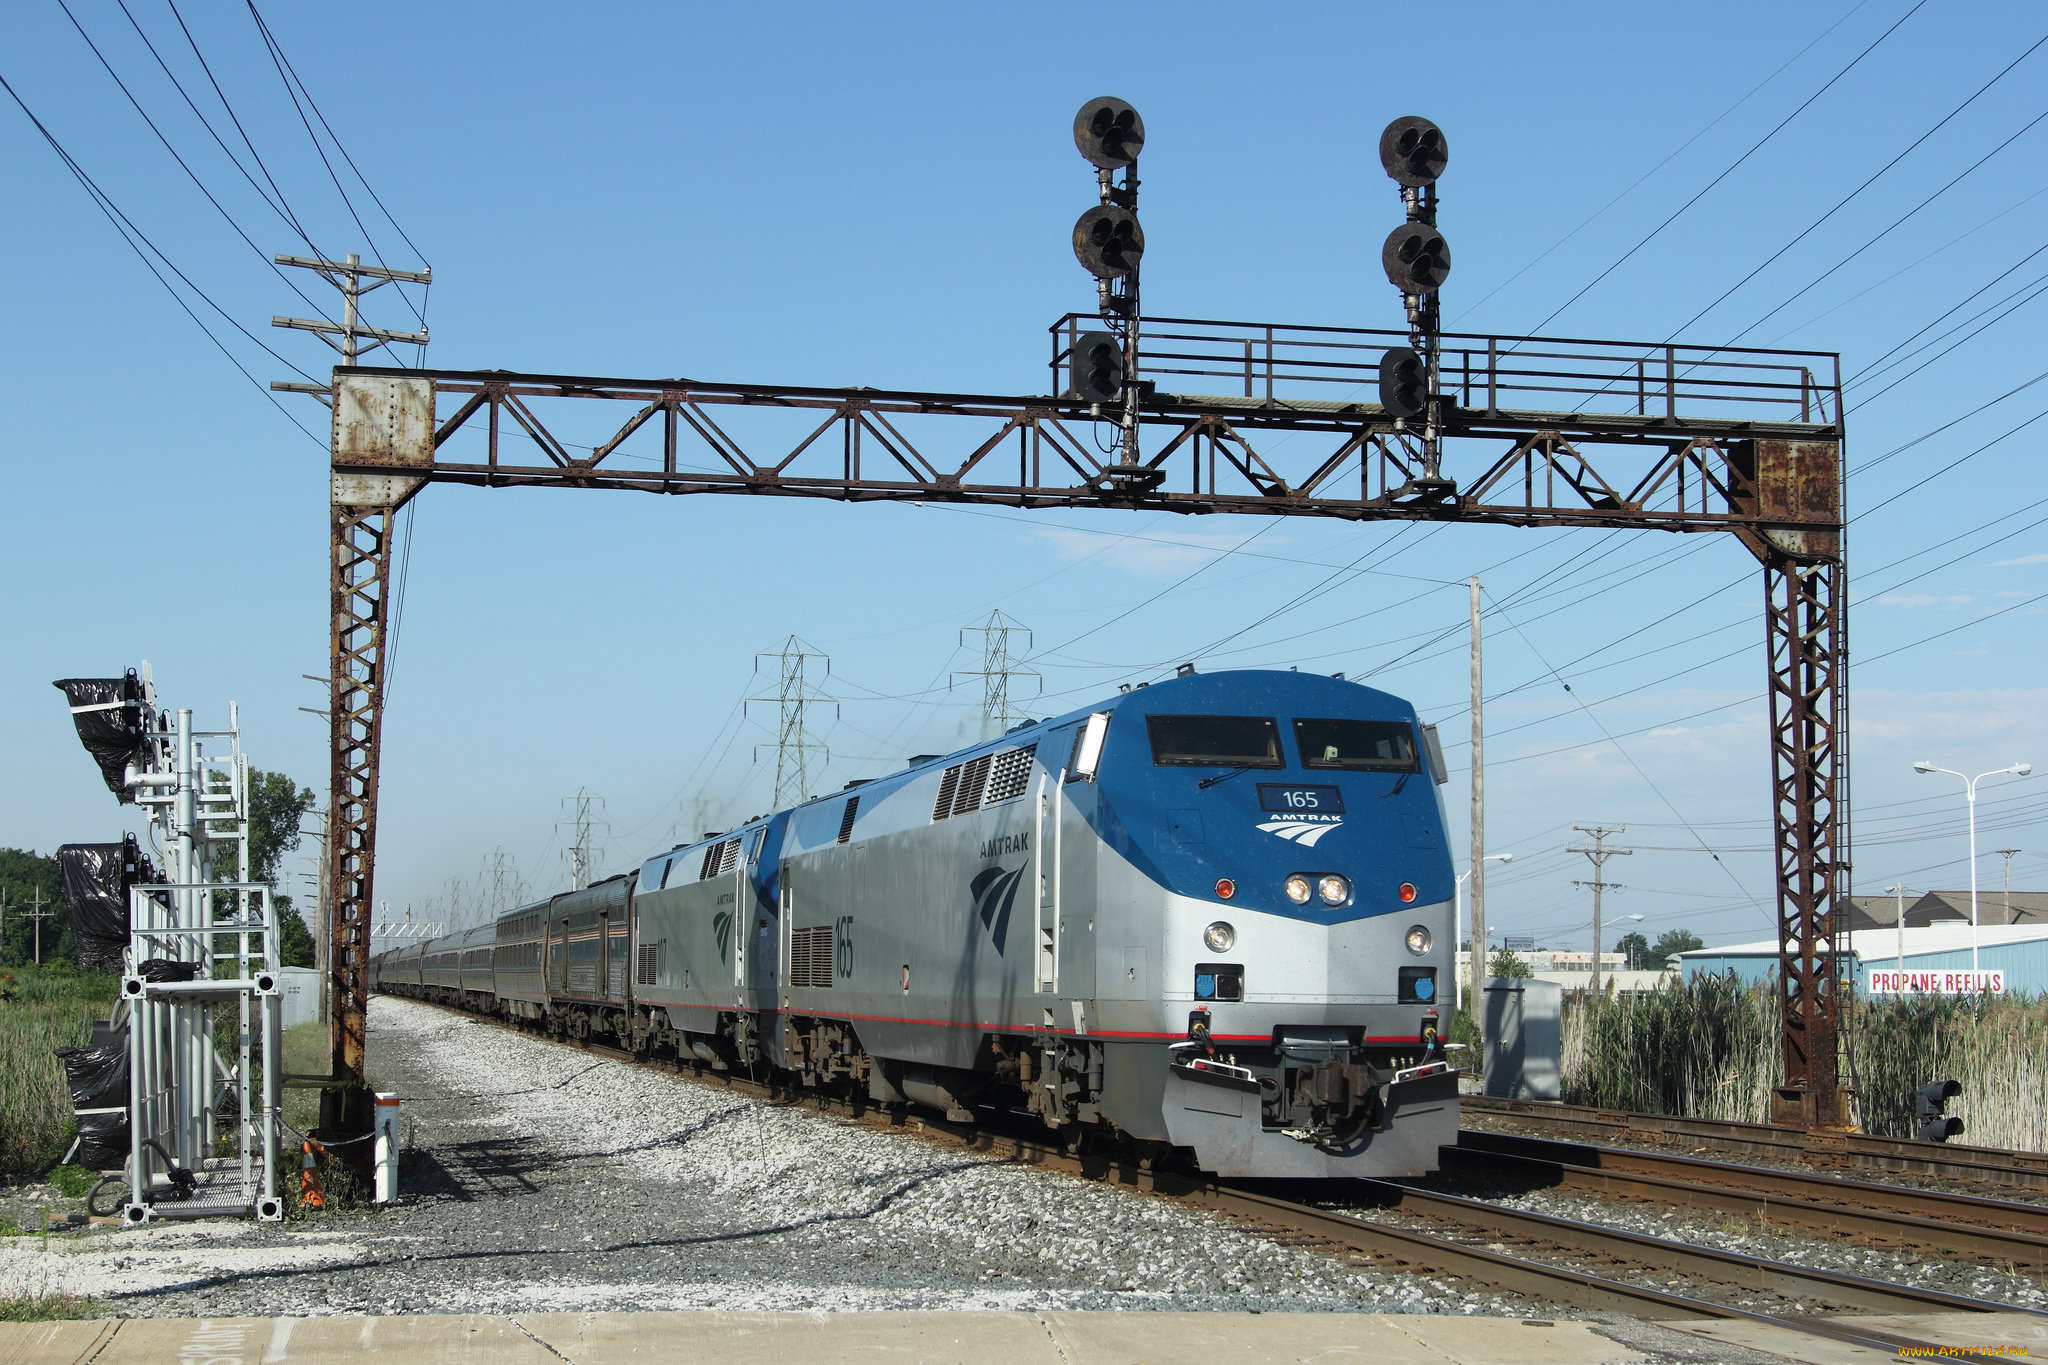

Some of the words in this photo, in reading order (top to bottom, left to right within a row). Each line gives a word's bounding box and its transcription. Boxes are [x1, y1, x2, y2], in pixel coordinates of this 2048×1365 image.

[1283, 791, 1319, 808] 165
[1270, 814, 1342, 822] AMTRAK
[980, 832, 1028, 859] AMTRAK
[836, 915, 854, 978] 165
[1872, 973, 1937, 991] PROPANE
